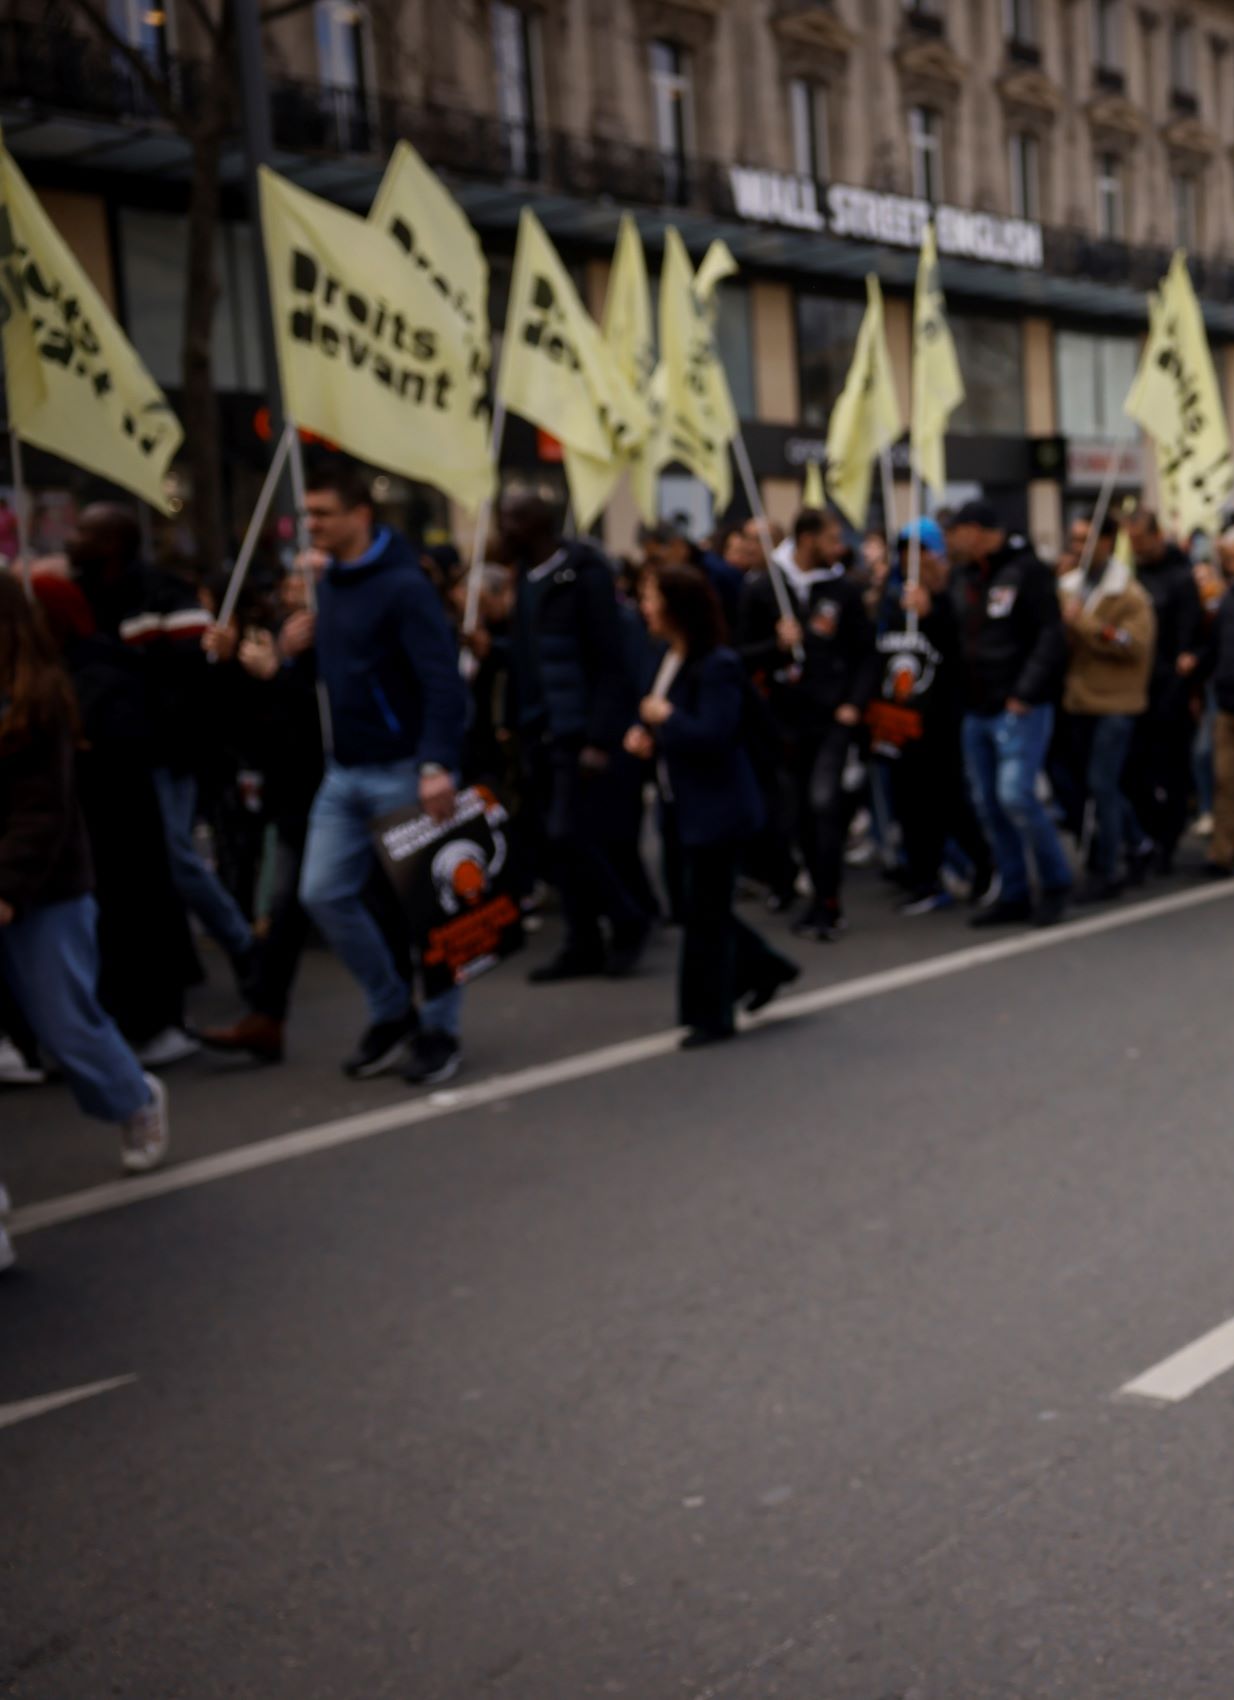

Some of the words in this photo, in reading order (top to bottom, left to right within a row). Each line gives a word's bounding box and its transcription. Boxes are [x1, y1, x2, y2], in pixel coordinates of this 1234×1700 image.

[730, 166, 826, 232] WALL
[827, 183, 932, 250] STREET
[935, 202, 1044, 268] ENGLISH
[291, 246, 438, 362] Droits
[290, 308, 455, 410] devant
